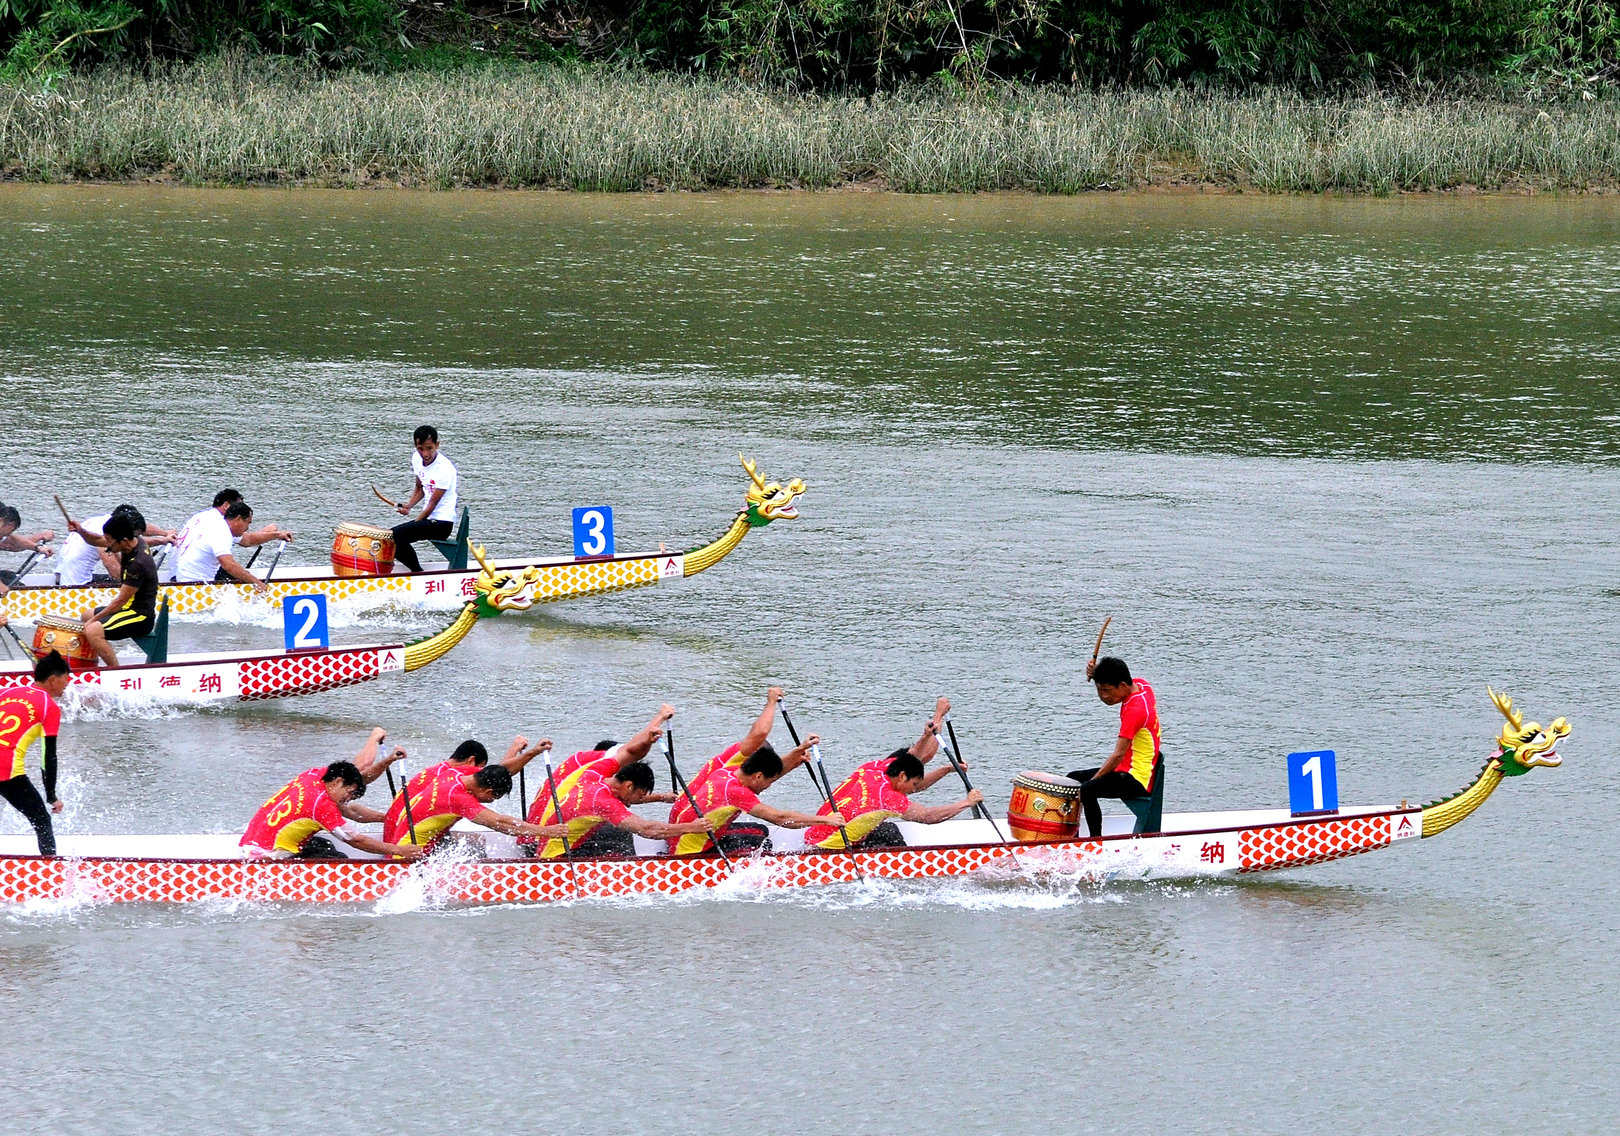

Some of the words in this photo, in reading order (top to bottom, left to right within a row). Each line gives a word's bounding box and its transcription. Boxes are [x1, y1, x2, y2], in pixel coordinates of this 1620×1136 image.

[581, 510, 606, 555] 3
[293, 598, 321, 648] 2
[1301, 756, 1324, 810] 1
